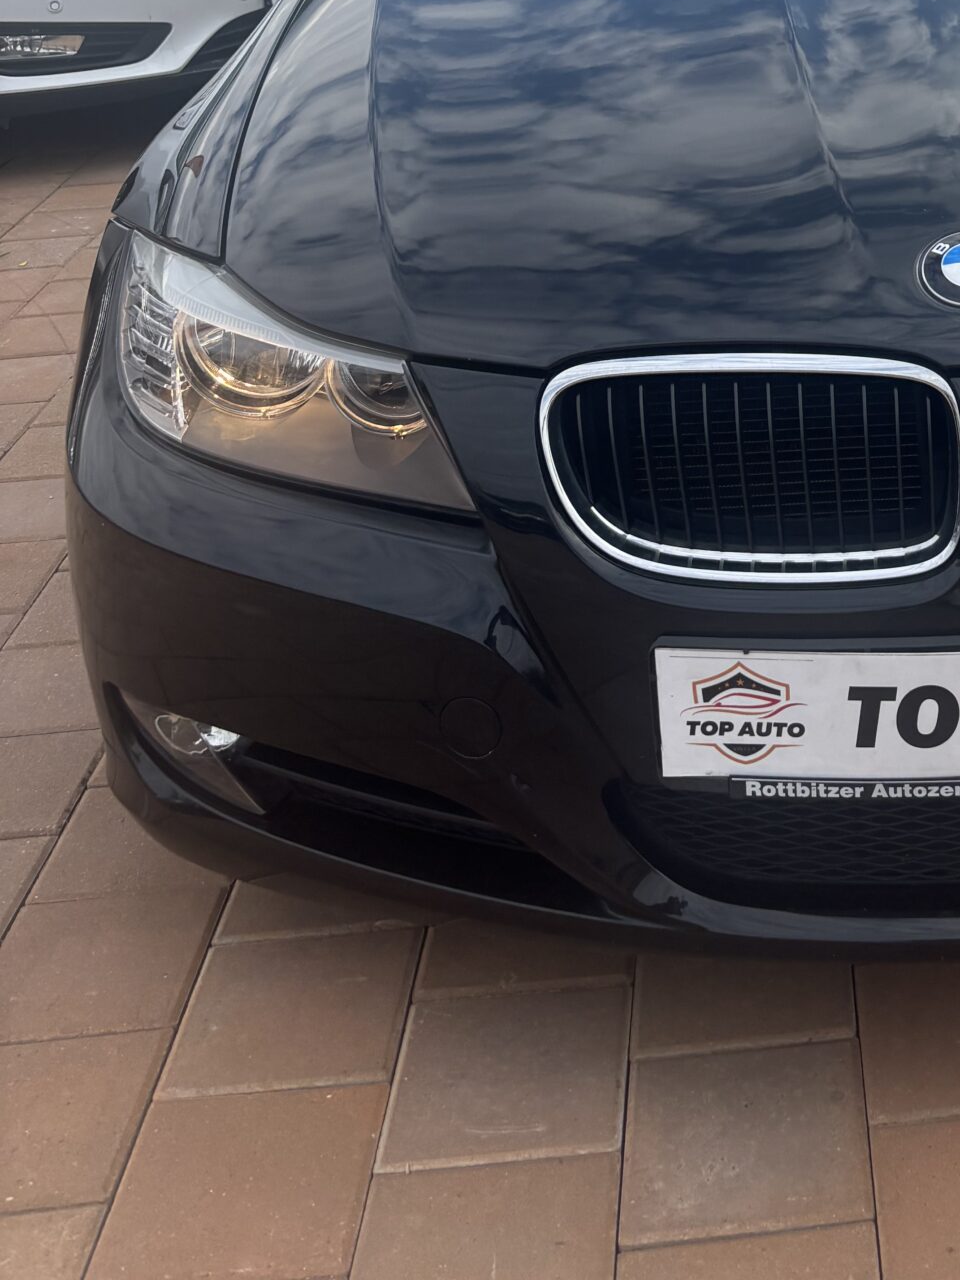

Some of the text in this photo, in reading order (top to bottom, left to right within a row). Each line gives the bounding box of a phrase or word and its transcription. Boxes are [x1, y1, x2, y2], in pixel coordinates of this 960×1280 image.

[686, 720, 806, 738] TOP AUTO
[745, 780, 864, 799] Rottbitzer
